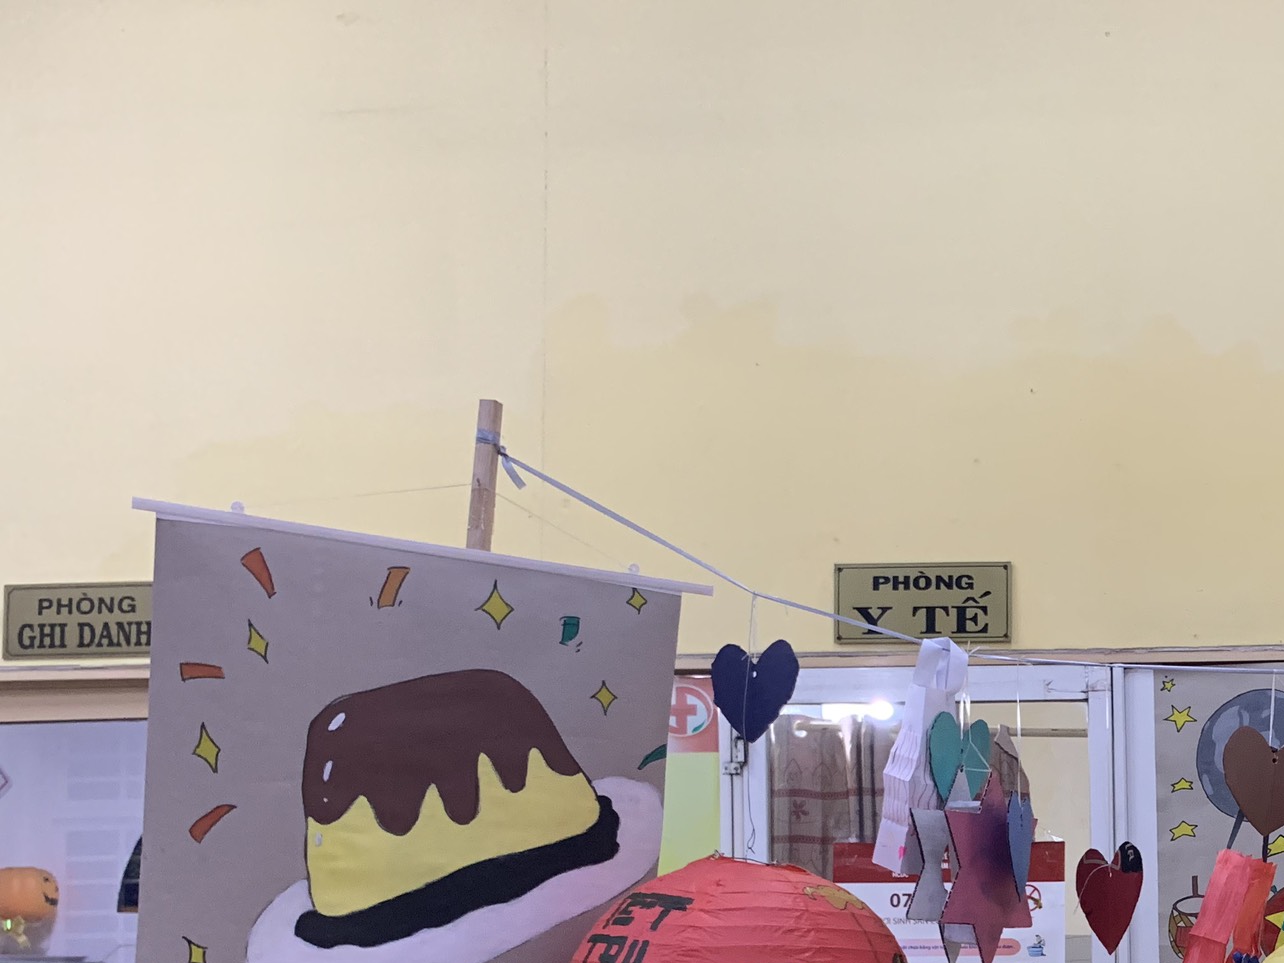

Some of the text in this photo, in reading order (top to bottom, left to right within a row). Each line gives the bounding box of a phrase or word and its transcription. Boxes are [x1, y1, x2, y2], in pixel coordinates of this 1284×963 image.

[872, 571, 974, 591] PHÒNG
[37, 592, 137, 616] PHÒNG
[853, 591, 992, 635] Y TẾ
[17, 621, 152, 649] GHI DANH
